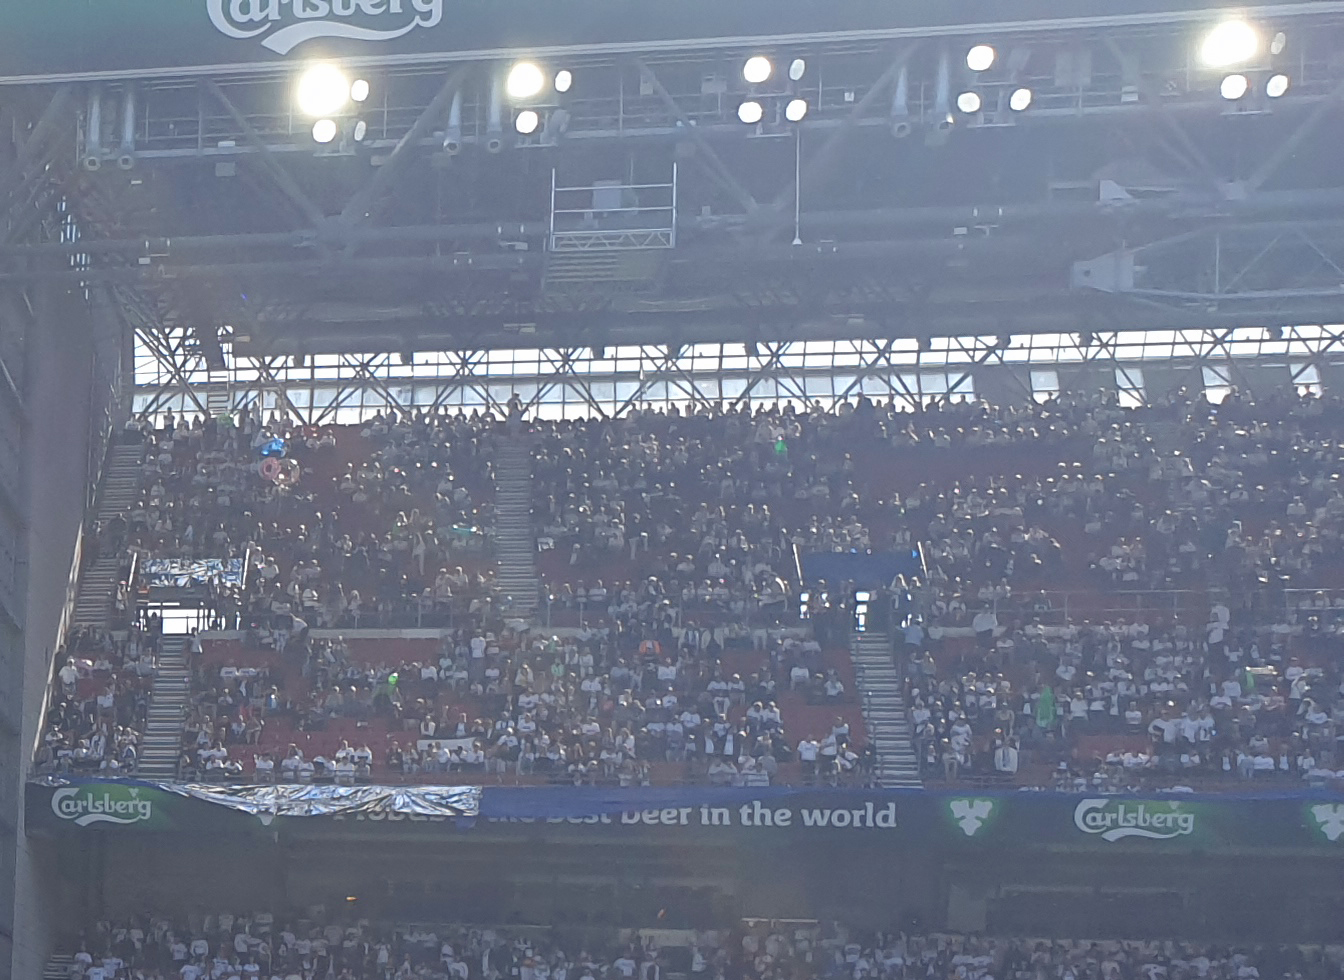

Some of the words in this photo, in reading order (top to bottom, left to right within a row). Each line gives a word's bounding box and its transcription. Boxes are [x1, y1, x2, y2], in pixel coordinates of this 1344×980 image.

[51, 787, 152, 822] Carlsberg
[701, 803, 731, 825] in
[739, 800, 792, 826] the
[800, 802, 897, 828] world
[1074, 798, 1195, 836] Carlsberg
